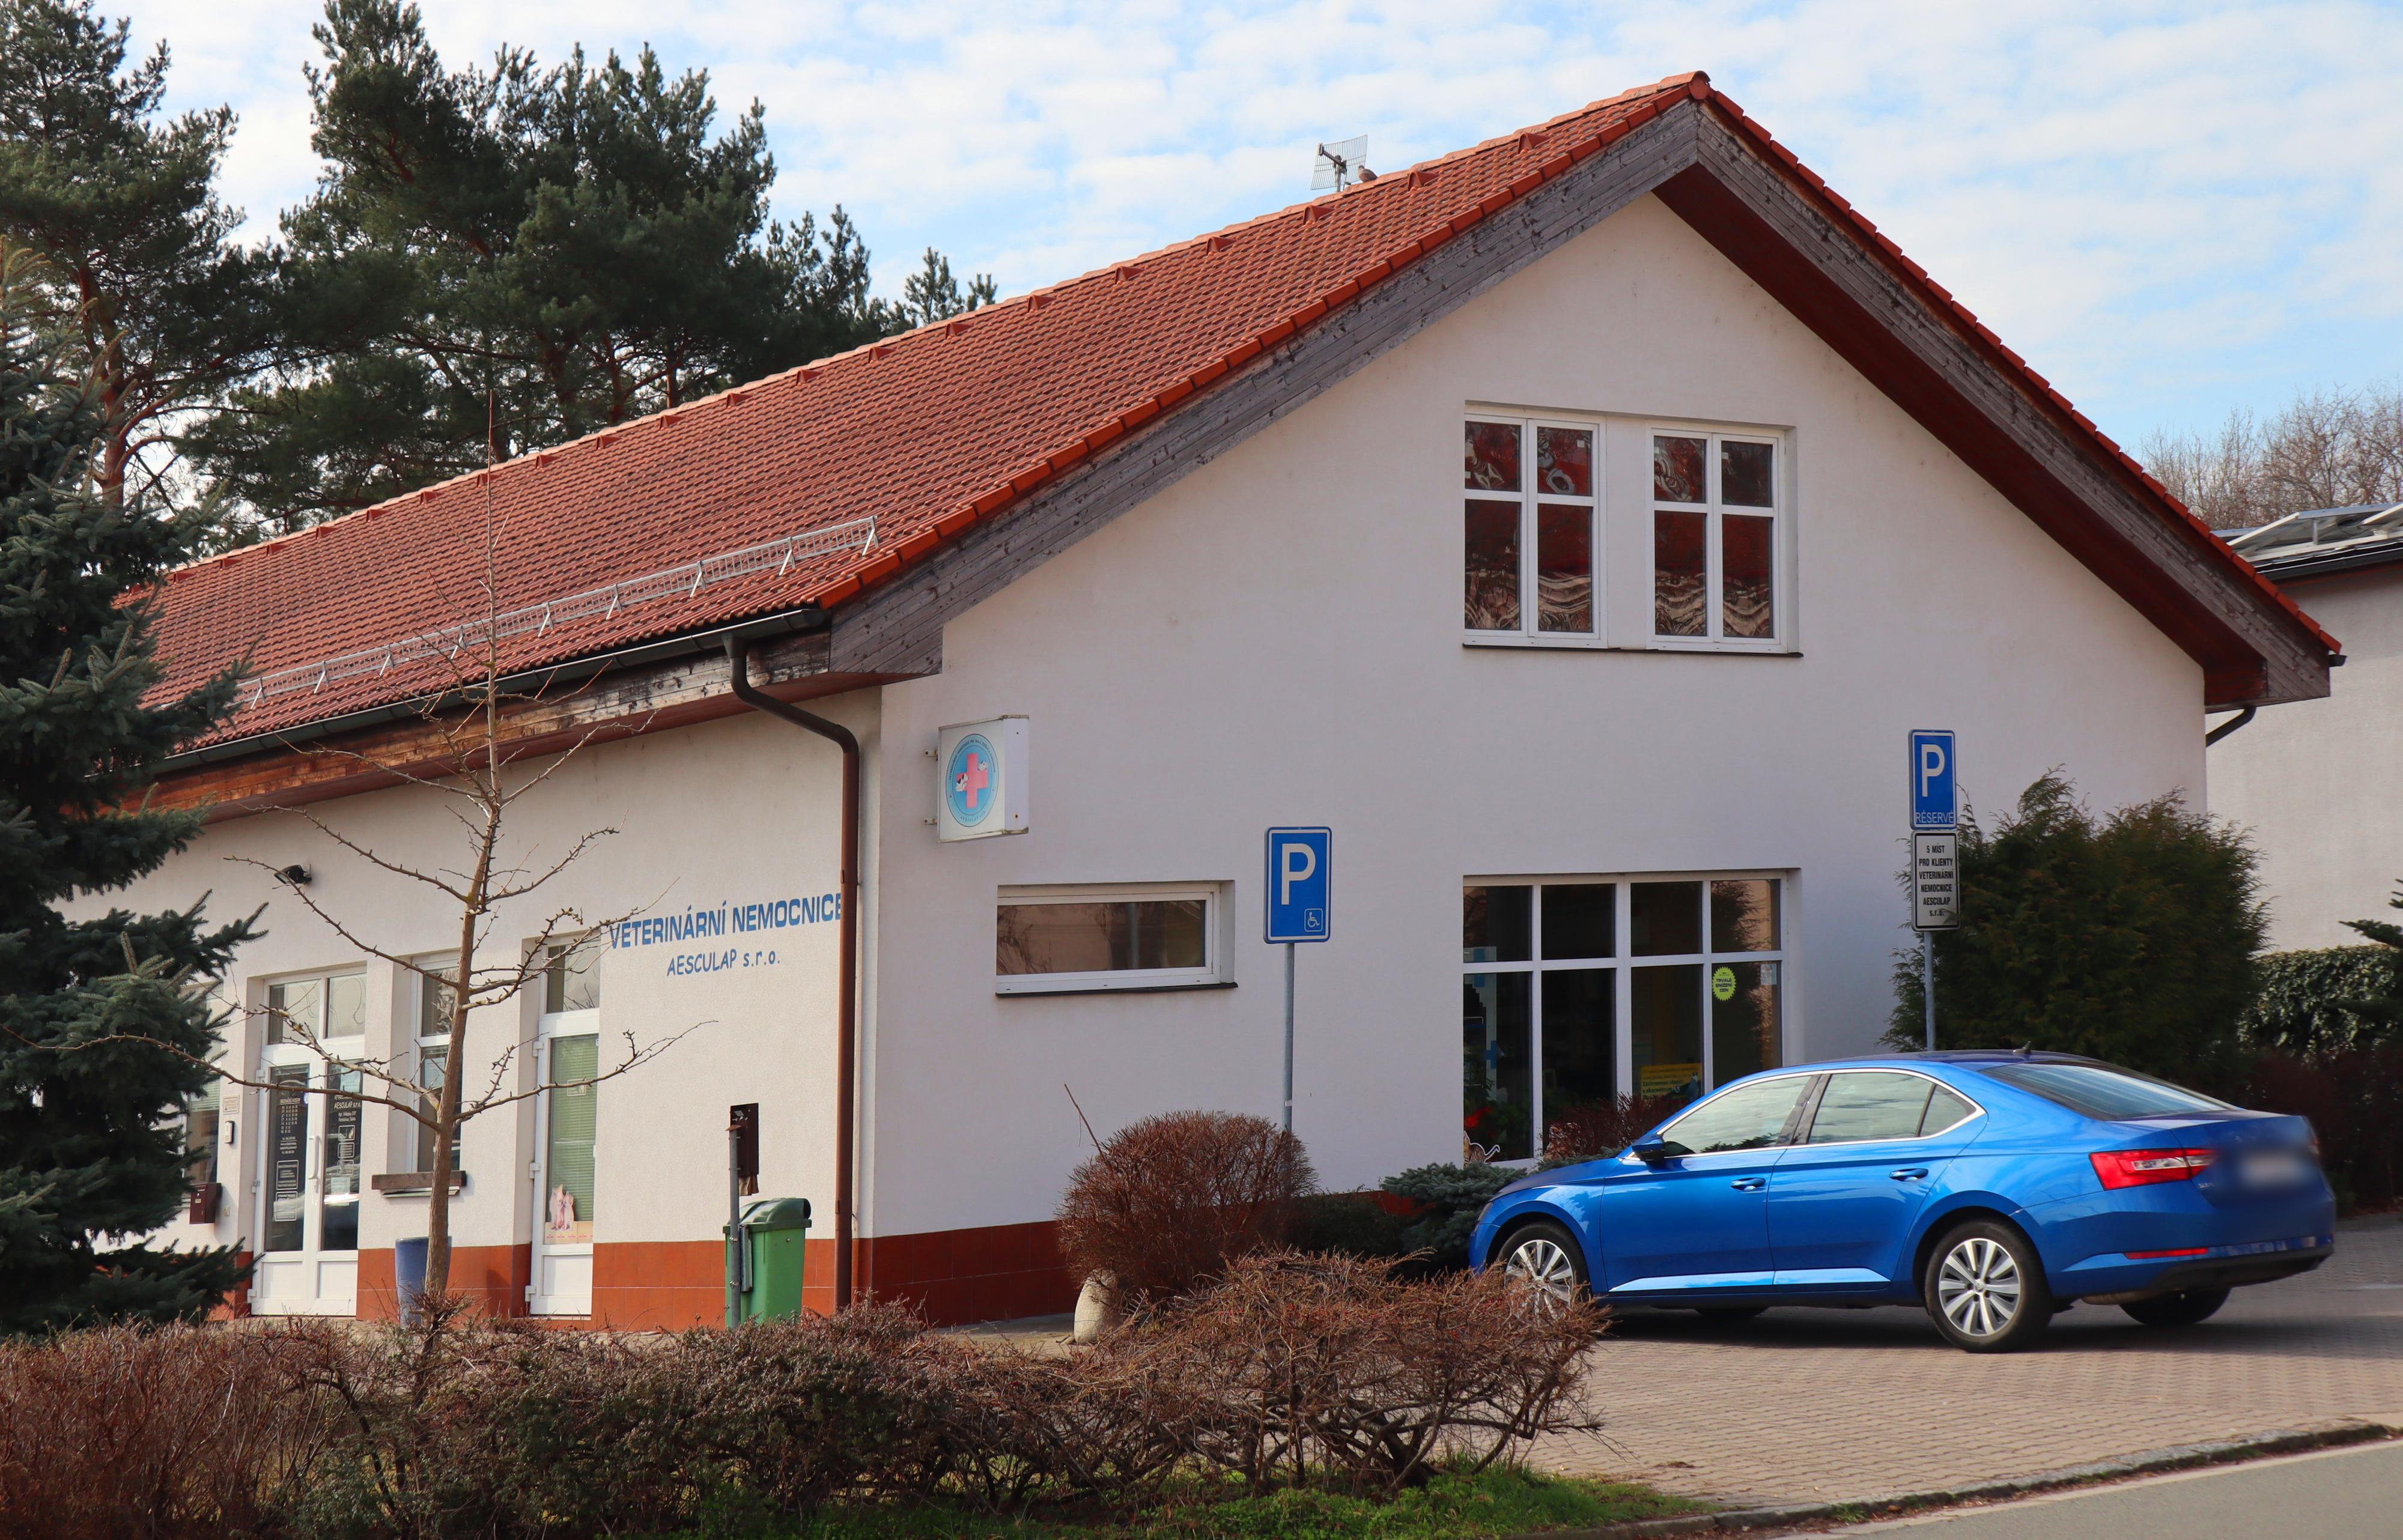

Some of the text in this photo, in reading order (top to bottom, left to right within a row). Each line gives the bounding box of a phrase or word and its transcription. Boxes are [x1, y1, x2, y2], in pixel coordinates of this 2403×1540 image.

[1921, 744, 1945, 797] P
[1931, 843, 1945, 853] MÍST
[1281, 843, 1316, 905] P
[1919, 869, 1954, 879] VETERINÁRNÍ
[1921, 884, 1952, 893] NEMOCNICE
[609, 900, 726, 949] VETERINÁRNÍ
[667, 949, 780, 976] AESCULAP s.r.o.
